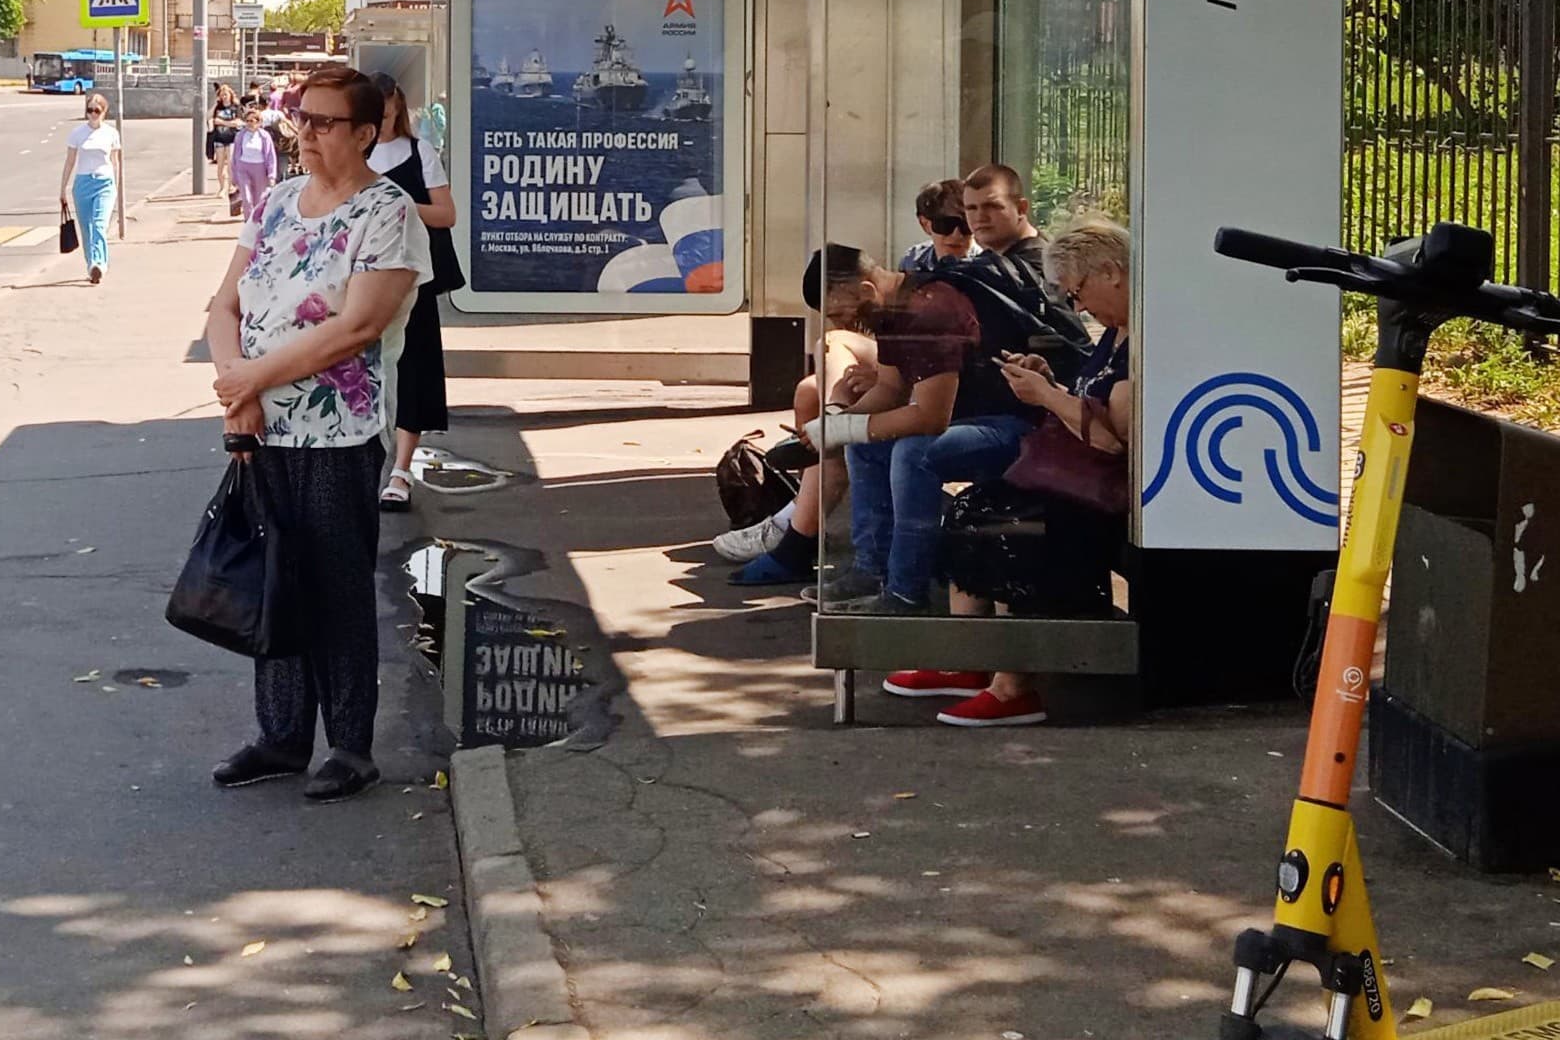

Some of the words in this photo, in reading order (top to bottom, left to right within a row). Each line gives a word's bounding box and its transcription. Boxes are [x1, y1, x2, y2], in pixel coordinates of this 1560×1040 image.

[661, 29, 696, 37] РОССИИ
[484, 131, 523, 148] ЕСТЬ
[527, 131, 577, 149] ТАКАЯ
[582, 132, 679, 150] ПРОФЕССИЯ
[483, 154, 605, 187] РОДИНУ
[481, 190, 652, 224] ЗАЩИЩАТЬ
[480, 231, 504, 241] ПУНКТ
[505, 232, 532, 241] ОТБОРА
[533, 232, 543, 242] НА
[544, 232, 573, 242] СЛУЖБУ
